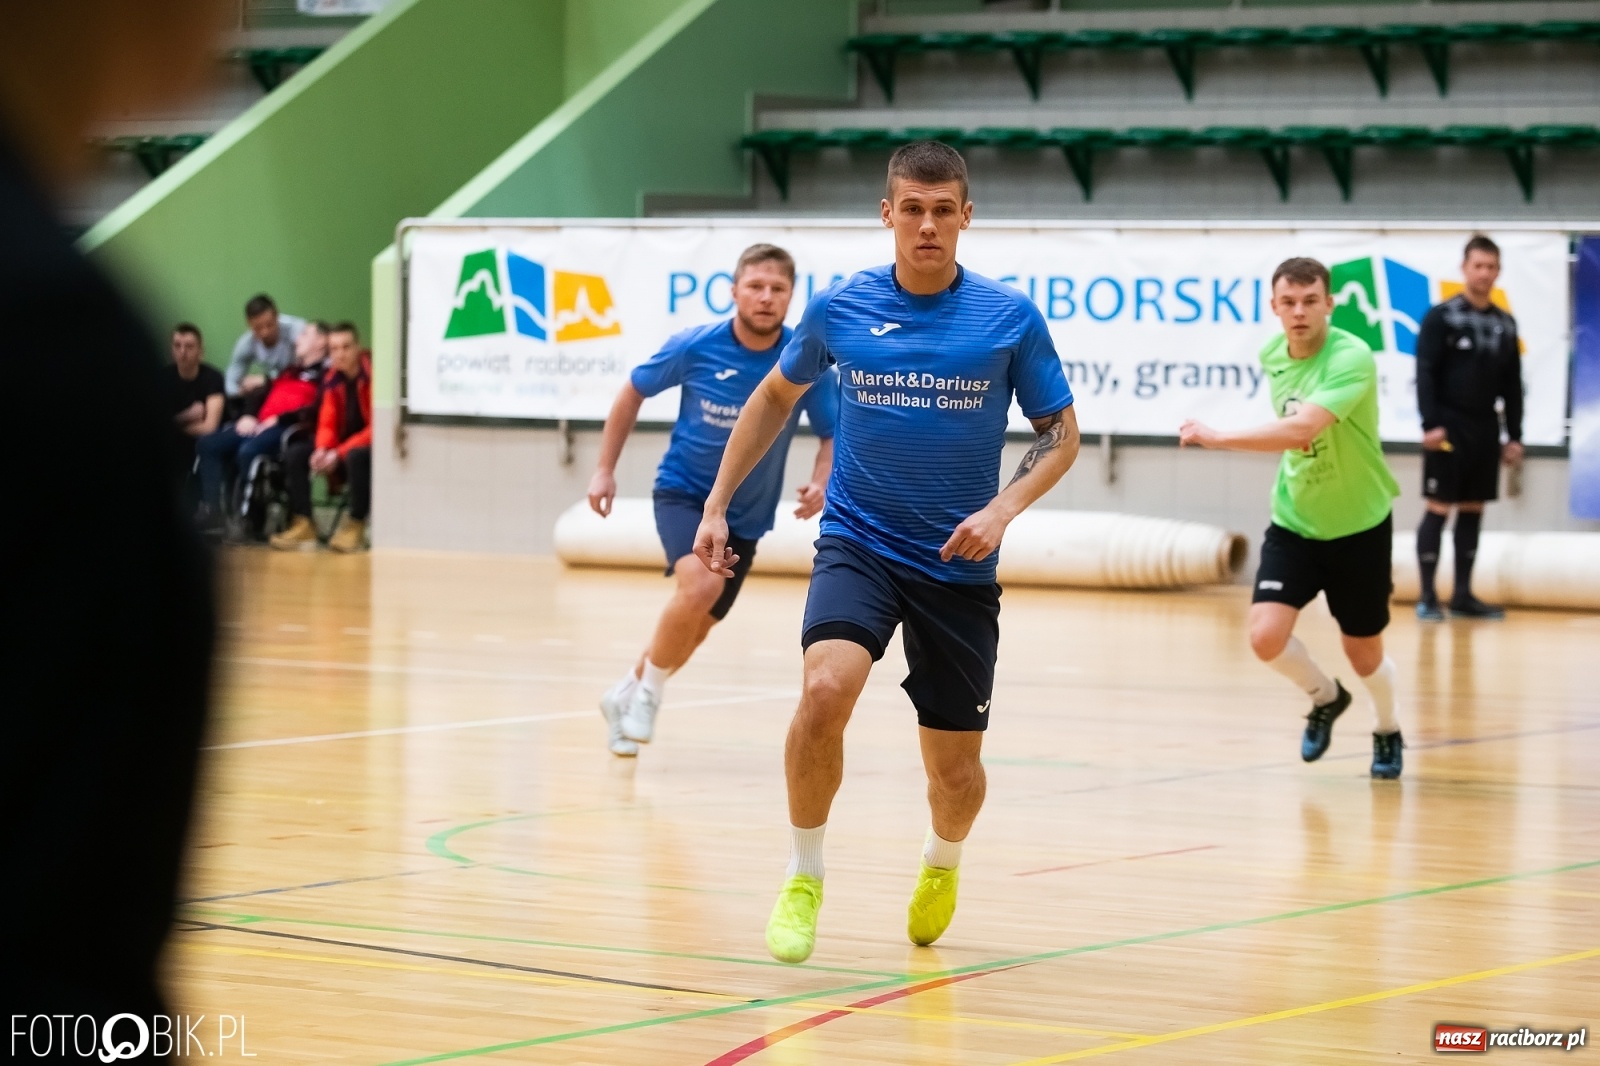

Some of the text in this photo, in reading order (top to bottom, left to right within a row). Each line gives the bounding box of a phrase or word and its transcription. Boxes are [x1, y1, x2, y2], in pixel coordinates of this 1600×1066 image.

[998, 275, 1262, 323] IBORSKI
[851, 370, 991, 392] Marek&Dariusz
[1134, 360, 1265, 399] gramy
[700, 398, 743, 417] Marek
[857, 390, 983, 409] Metallbau GmbH
